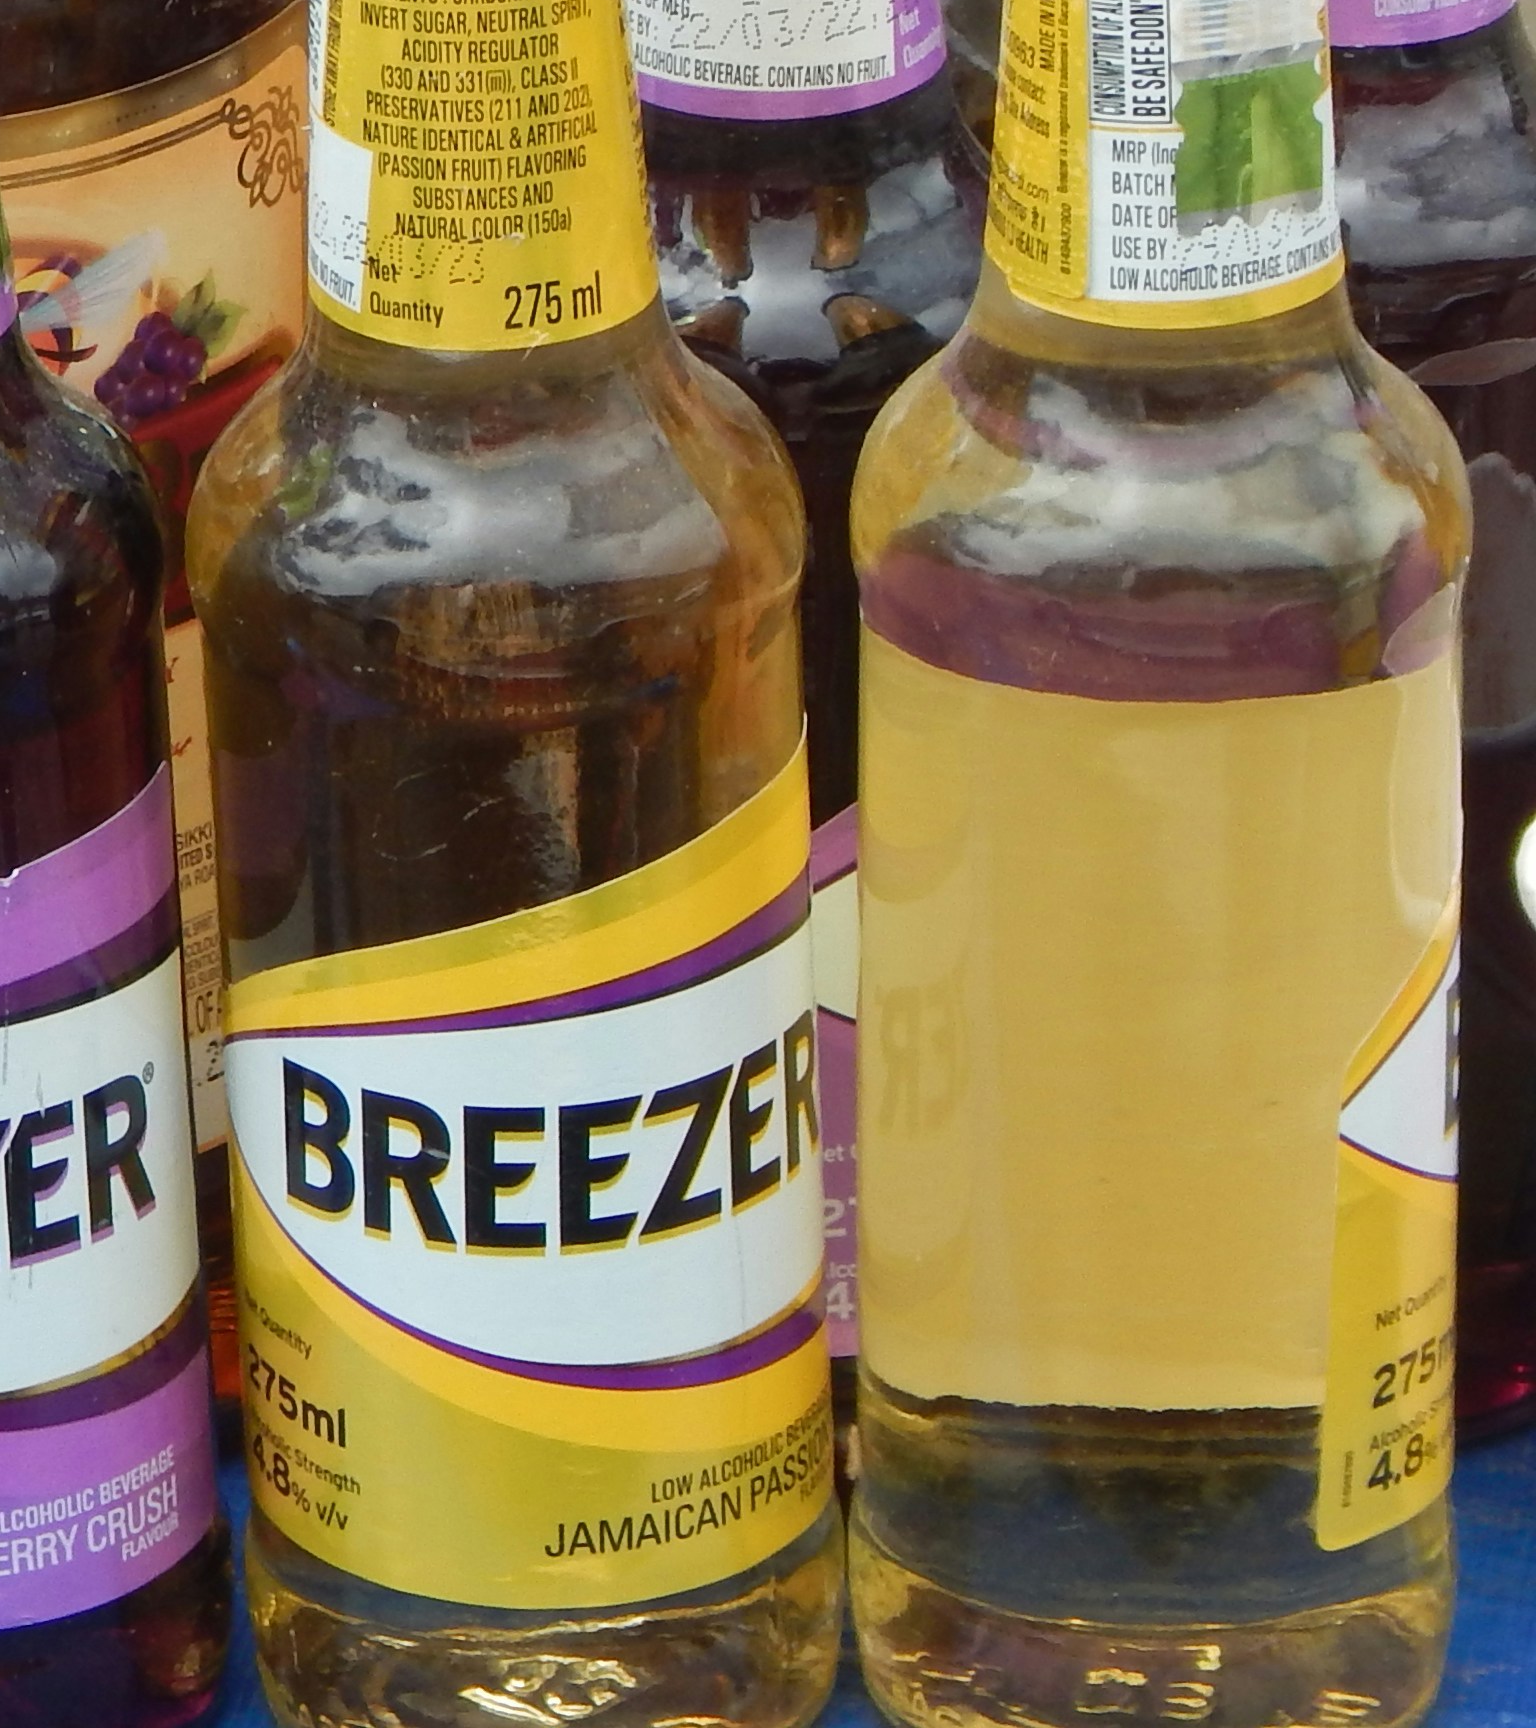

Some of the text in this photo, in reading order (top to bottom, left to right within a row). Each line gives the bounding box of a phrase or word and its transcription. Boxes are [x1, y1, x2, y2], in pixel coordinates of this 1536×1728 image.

[360, 0, 547, 35] INVERT SUGAR, NEUTRAL
[634, 43, 891, 88] ALCOHOLIC BEVERAGE. CONTAINS NO FRUIT.
[365, 89, 485, 124] PRESERVATIVES
[1112, 172, 1166, 197] BATCH
[1112, 236, 1167, 260] USE BY
[369, 269, 603, 330] Quantity 275 ml
[1110, 266, 1140, 291] LOW
[281, 1008, 819, 1257] BREEZER
[248, 1342, 348, 1449] 275ml
[99, 1444, 176, 1507] BEVERAGE
[293, 1452, 362, 1497] Strength
[651, 1435, 784, 1504] LOW ALCOHOLIC
[86, 1474, 178, 1552] CRUSH
[122, 1513, 179, 1562] FLAVOUR
[544, 1491, 741, 1558] JAMAICAN
